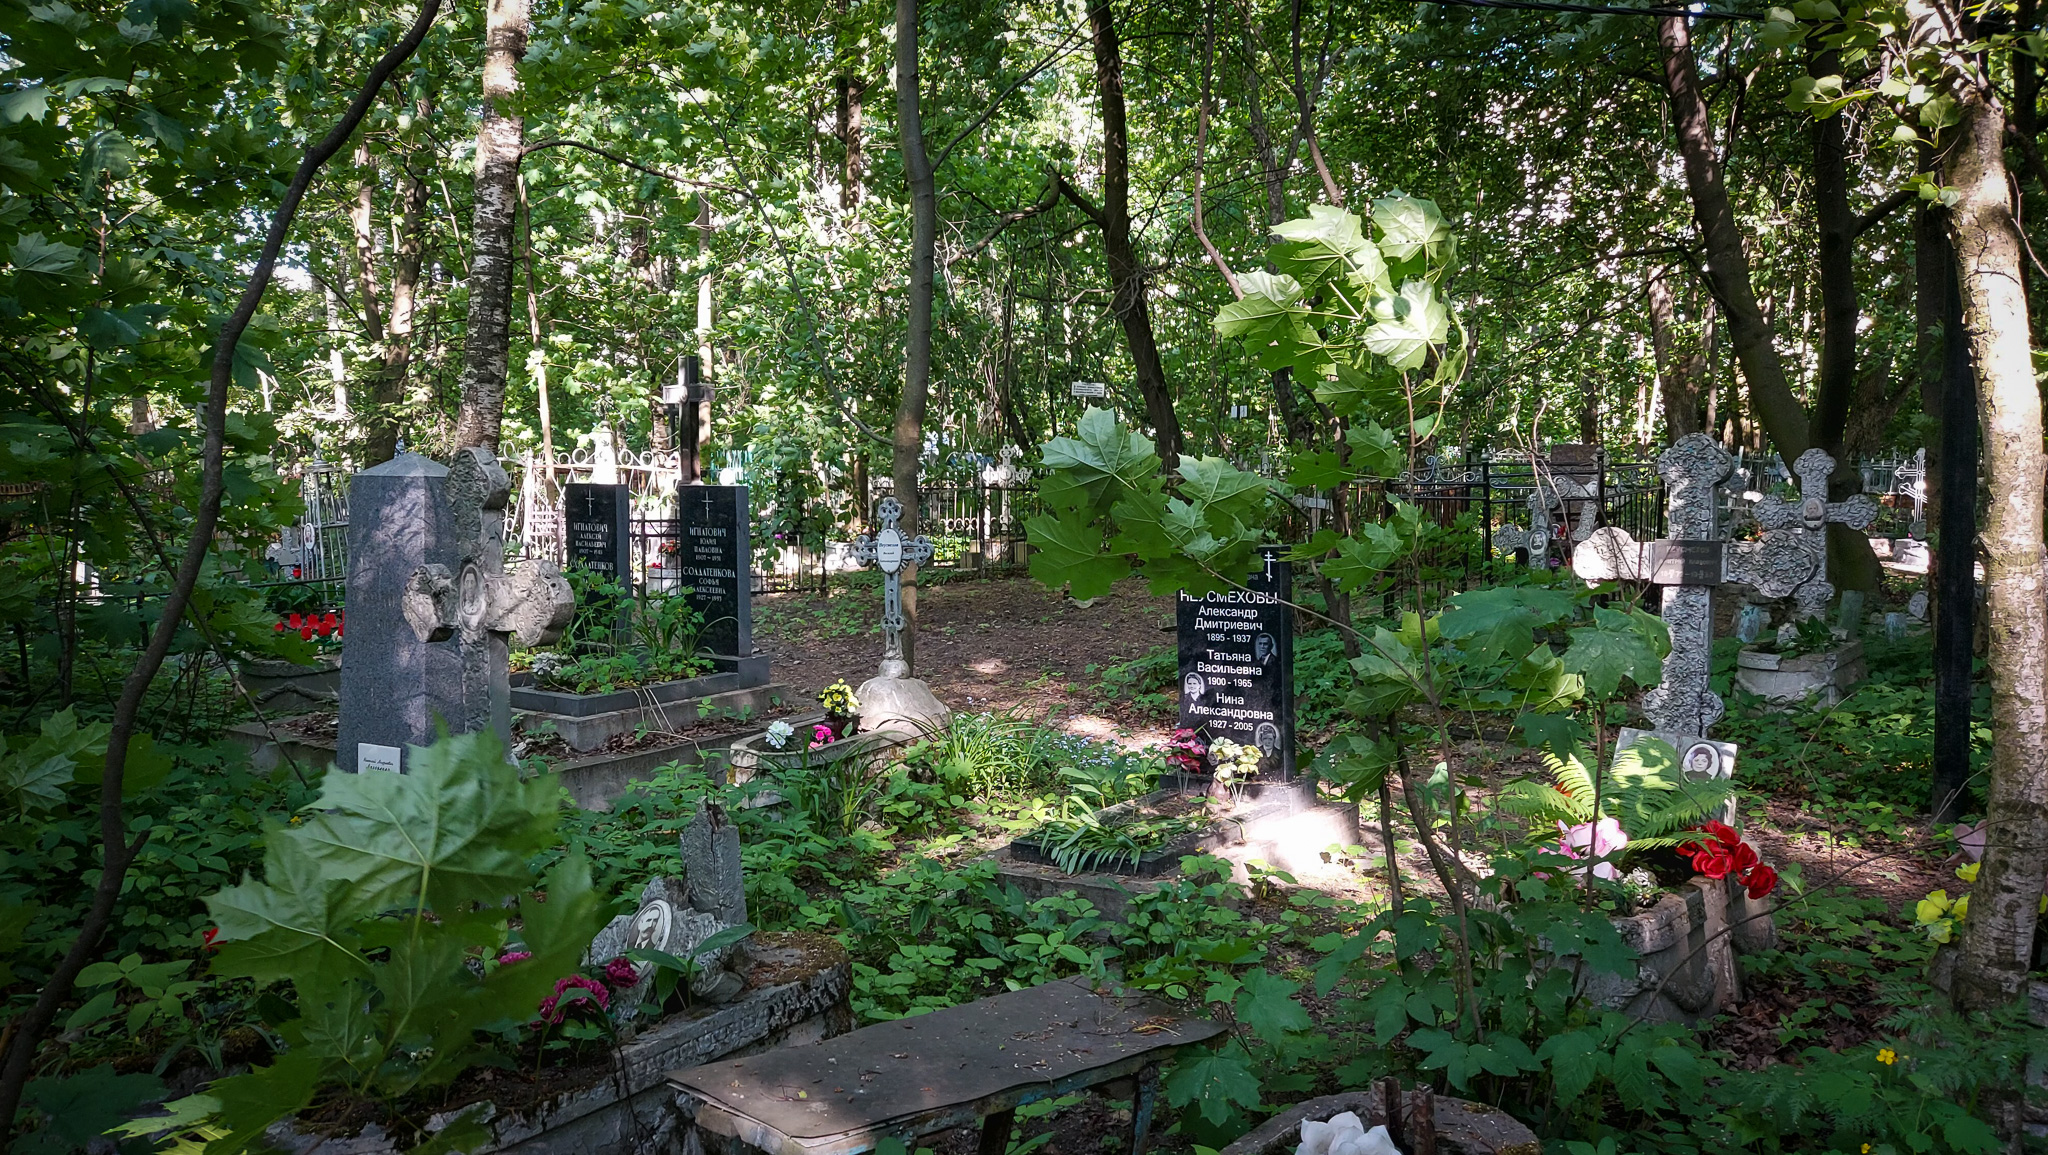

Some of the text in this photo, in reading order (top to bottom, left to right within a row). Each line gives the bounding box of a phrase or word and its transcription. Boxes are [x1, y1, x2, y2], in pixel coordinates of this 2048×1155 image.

[689, 527, 726, 537] ИГНАТОВИЧ
[682, 566, 736, 578] СОЛДАТЕНКОВА
[1180, 590, 1278, 604] НСМЕХОВЫ
[1198, 605, 1258, 620] Александр
[1194, 617, 1263, 631] Дмитриевич
[1207, 633, 1225, 641] 1895
[1233, 634, 1251, 643] 1937
[1206, 649, 1252, 662] Татьяна
[1197, 661, 1262, 676] Васильевна
[1207, 676, 1226, 686] 1900
[1233, 679, 1252, 688] 1965
[1216, 692, 1244, 705] Нина
[1188, 703, 1274, 720] Александровна
[1209, 719, 1227, 729] 1927
[1234, 721, 1253, 731] 2005
